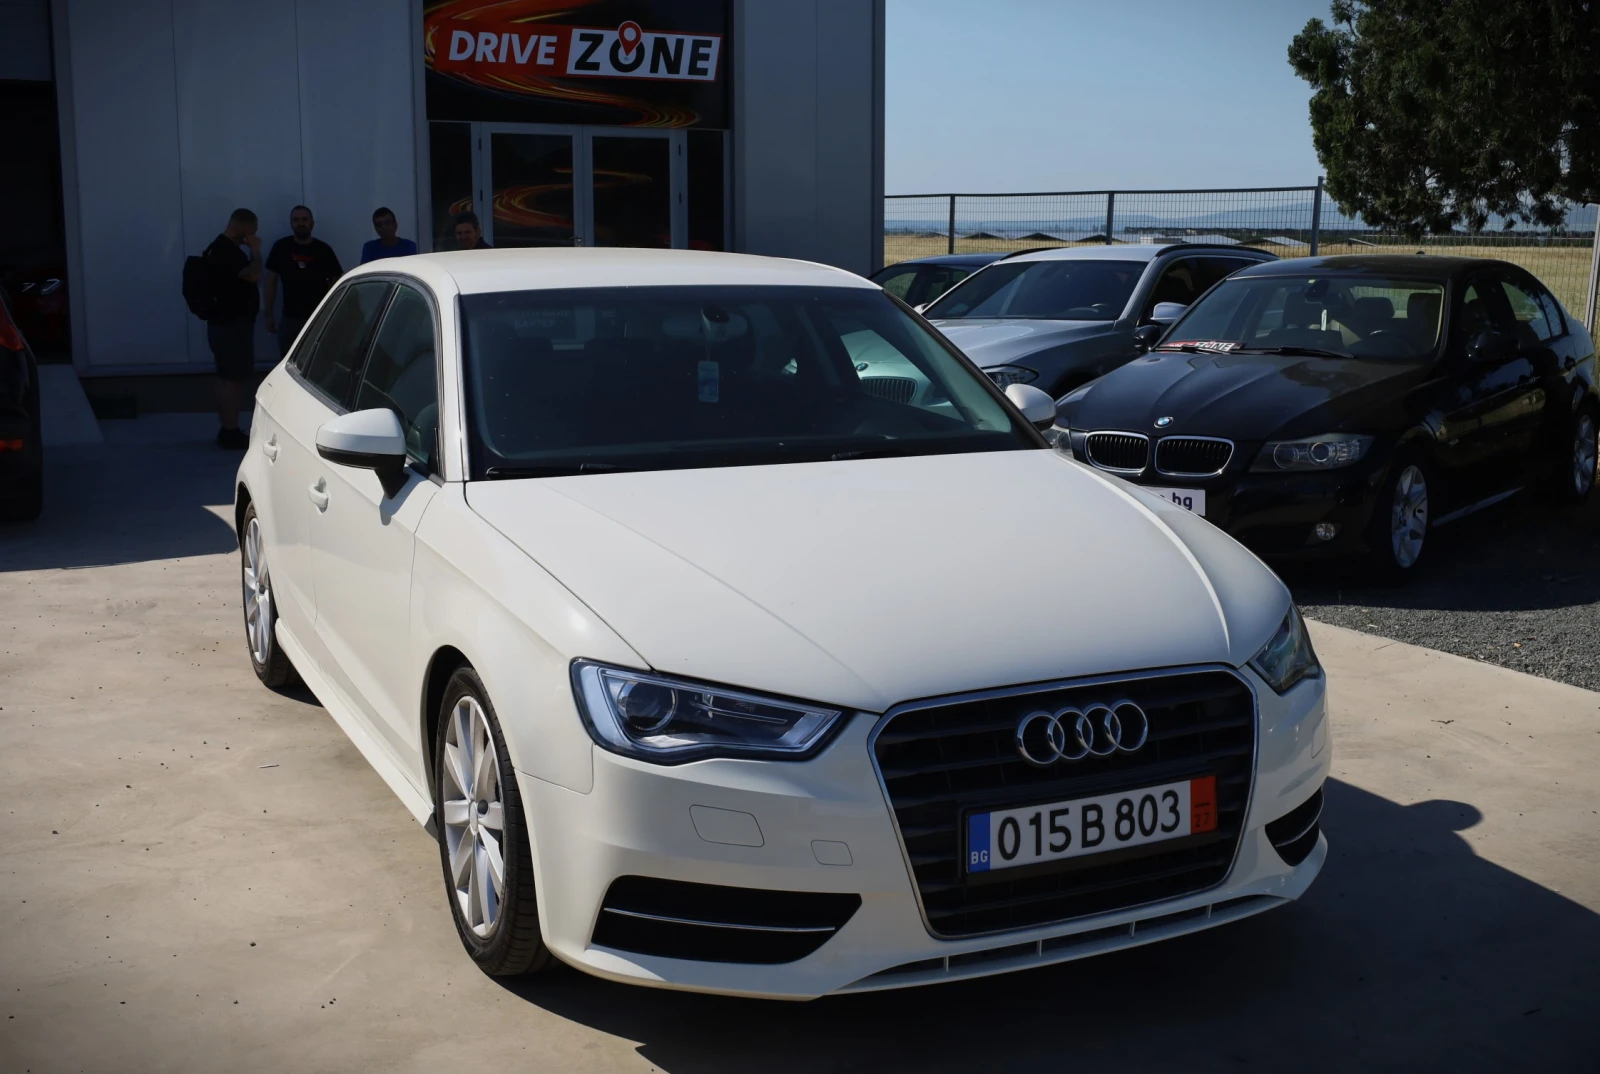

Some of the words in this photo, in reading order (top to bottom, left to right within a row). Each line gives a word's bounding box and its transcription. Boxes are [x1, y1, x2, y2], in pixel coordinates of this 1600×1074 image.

[449, 30, 558, 65] DRIVE
[574, 32, 713, 77] ZONE
[971, 850, 988, 865] BG
